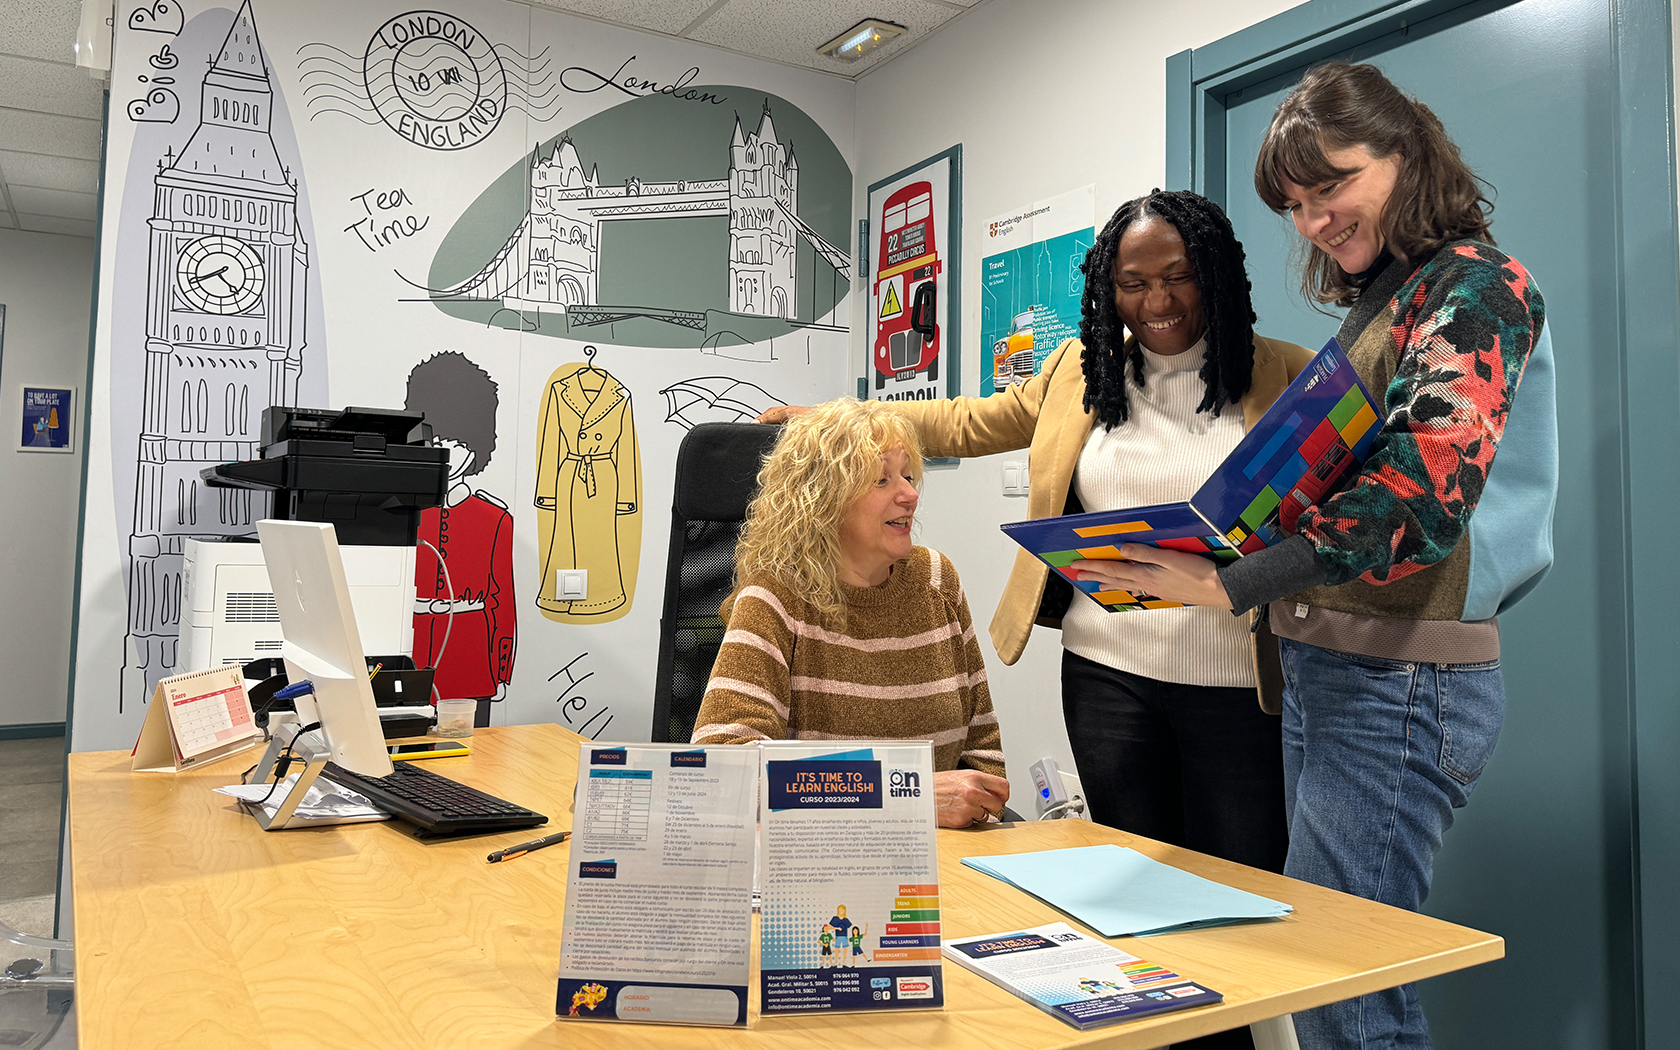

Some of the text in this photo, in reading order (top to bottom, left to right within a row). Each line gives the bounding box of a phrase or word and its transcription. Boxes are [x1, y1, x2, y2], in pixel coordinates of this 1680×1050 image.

[379, 17, 475, 50] LONDON
[409, 72, 430, 92] 10
[560, 55, 727, 105] London
[399, 98, 498, 147] ENGLAND
[350, 188, 413, 216] Tea
[999, 206, 1051, 228] Cambridge Assessment
[344, 215, 430, 252] Time
[999, 226, 1013, 236] English
[888, 234, 898, 253] 22
[888, 244, 925, 265] PICCADILLY CIRCUS
[924, 266, 930, 276] 22
[989, 259, 1005, 270] Travel
[1033, 332, 1056, 340] Motorway
[1033, 339, 1054, 350] Traffic
[878, 386, 936, 401] ONDON
[797, 772, 862, 782] IT'S TIME TO
[786, 783, 874, 793] LEARN ENGLISH!
[890, 787, 920, 797] time
